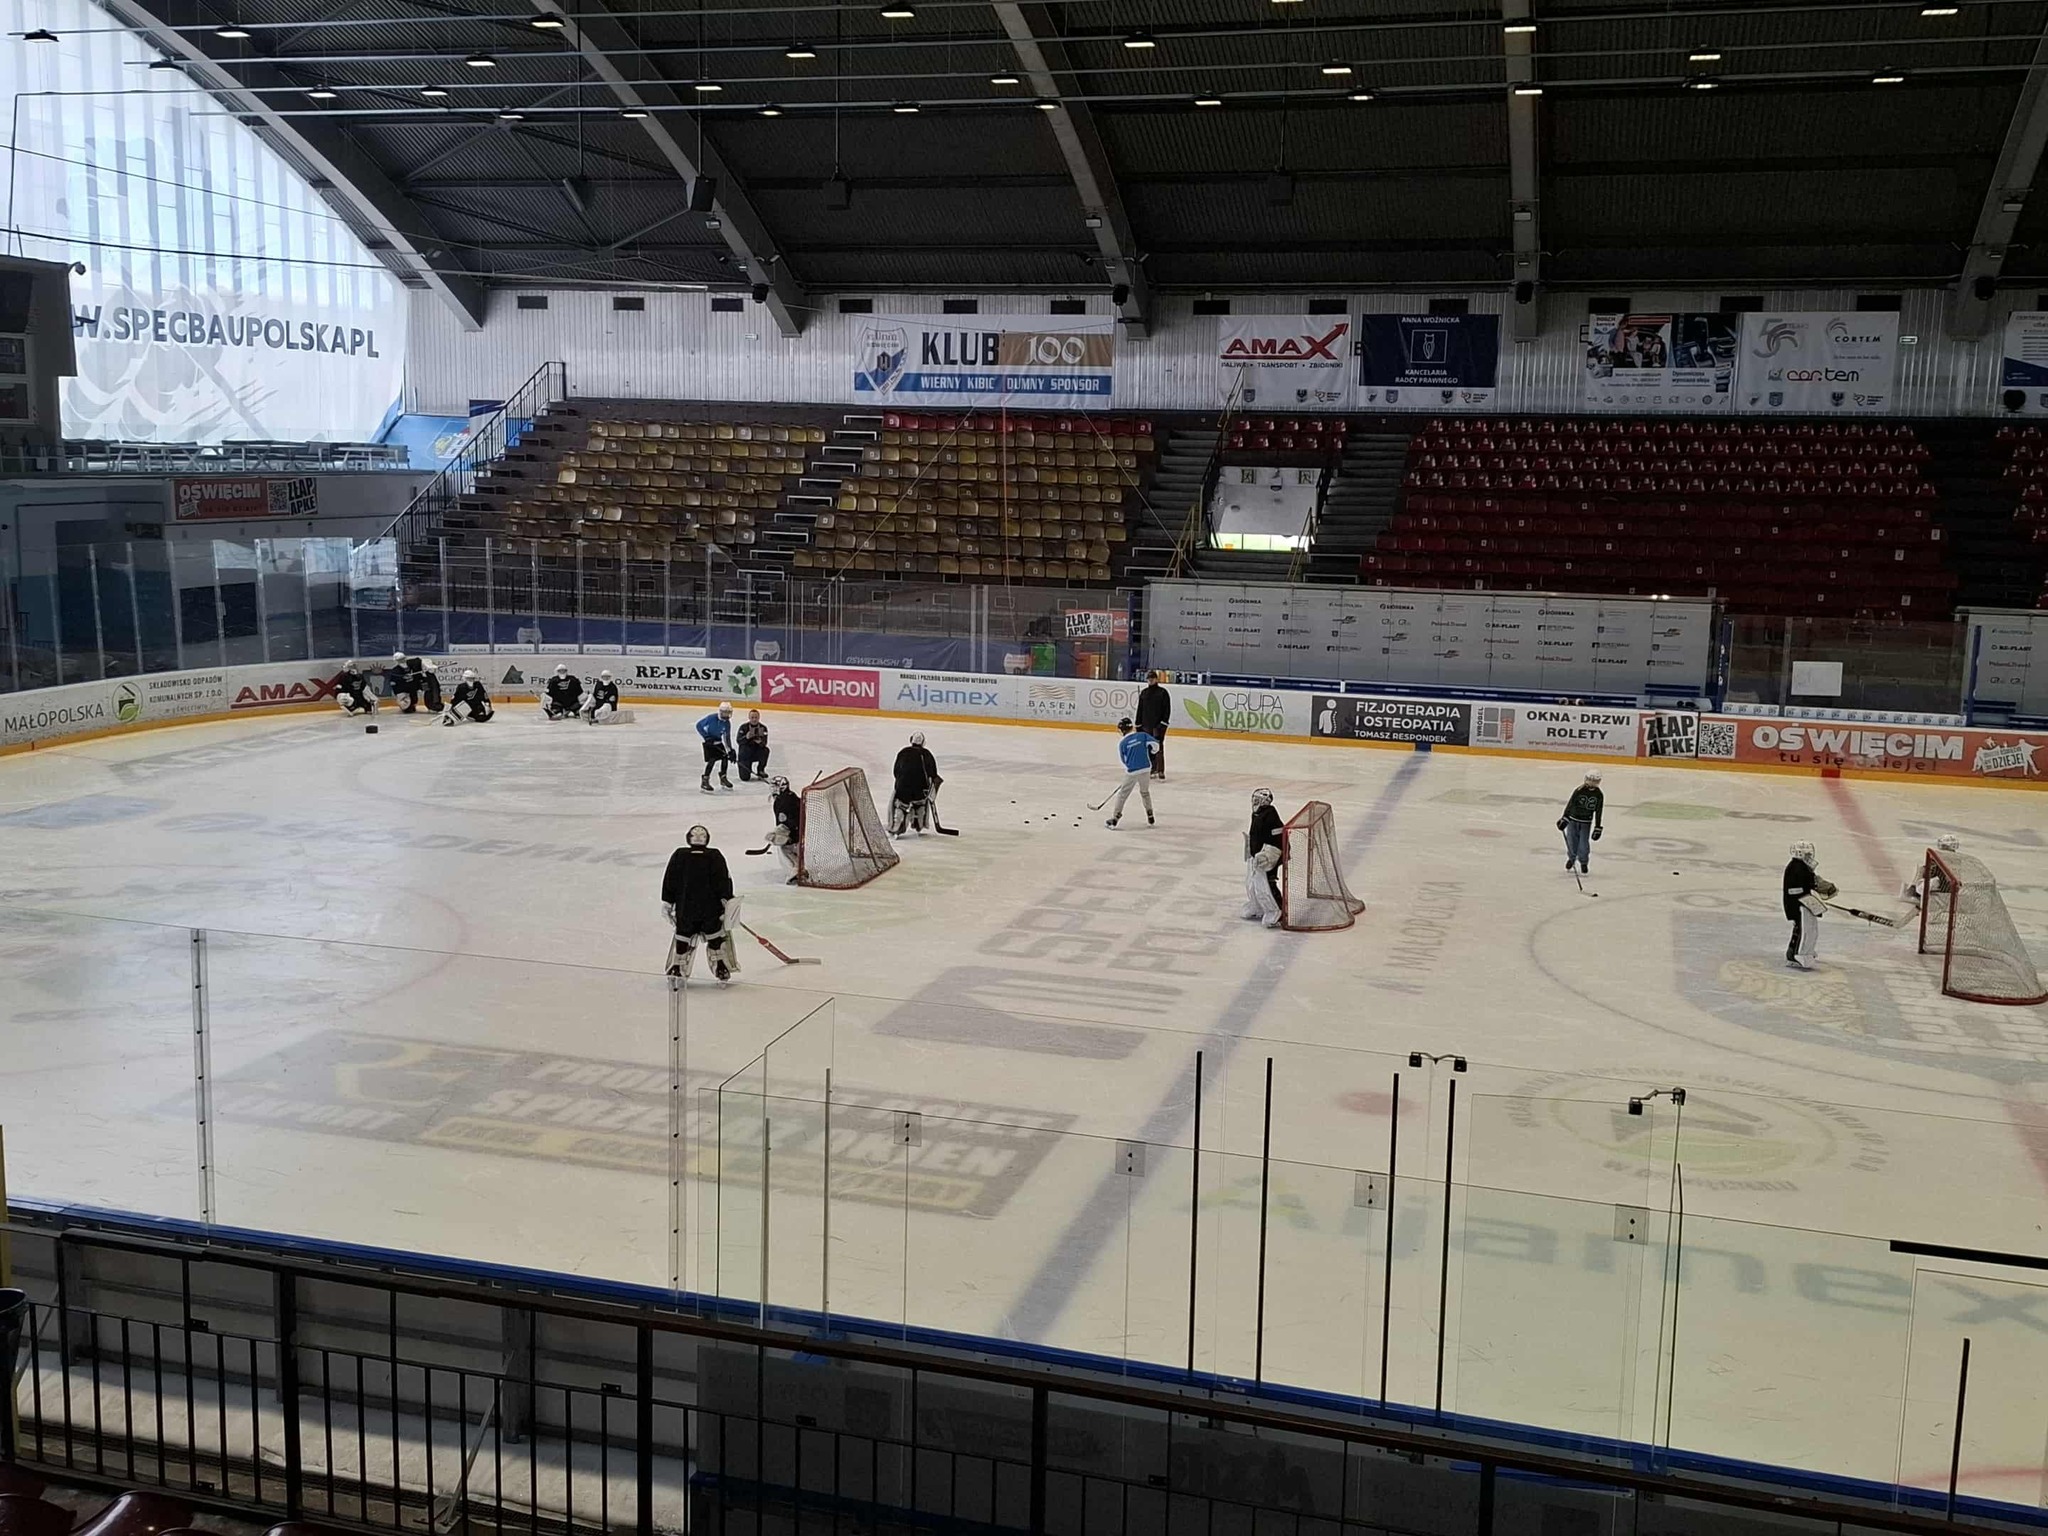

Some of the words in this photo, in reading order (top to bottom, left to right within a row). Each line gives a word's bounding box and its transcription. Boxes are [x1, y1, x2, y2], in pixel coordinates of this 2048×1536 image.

[921, 332, 1000, 365] KLUB
[1025, 335, 1086, 365] 100
[1225, 323, 1349, 360] AMAX
[920, 376, 961, 389] WIERNY
[967, 376, 995, 389] KIBIC
[1006, 377, 1044, 391] DUMNY
[1050, 378, 1099, 391] SPONSOR
[180, 481, 261, 501] OŚWIĘCIM
[288, 477, 314, 501] ZŁAP
[290, 497, 316, 515] APKE
[1066, 613, 1090, 627] ZŁAP
[1068, 625, 1091, 635] APKE
[149, 678, 191, 690] SKŁADOWISKO
[192, 675, 222, 685] ODPADÓW
[636, 665, 723, 682] RE-PLAST
[235, 671, 343, 702] AMAX
[635, 683, 681, 691] TWORZYWA
[683, 684, 723, 692] SZTUCZNE
[795, 678, 875, 698] TAURON
[897, 683, 998, 707] Aljamex
[1028, 700, 1076, 710] BASEN
[1222, 693, 1285, 714] GRUPA
[1356, 701, 1461, 719] FIZJOTERAPIA
[4, 703, 105, 733] MAŁOPOLSKA
[1224, 710, 1284, 731] RADKO
[1364, 716, 1455, 733] OSTEOPATIA
[1526, 711, 1570, 723] OKNA
[1580, 713, 1631, 726] DRZWI
[1354, 730, 1390, 740] TOMASZ
[1392, 732, 1447, 743] RESPONDEK
[1547, 727, 1608, 740] ROLETY
[1646, 715, 1694, 740] ZŁAP
[1752, 723, 1964, 761] OŚWIĘCIM
[1779, 751, 1801, 763] tu
[1812, 753, 1844, 767] się
